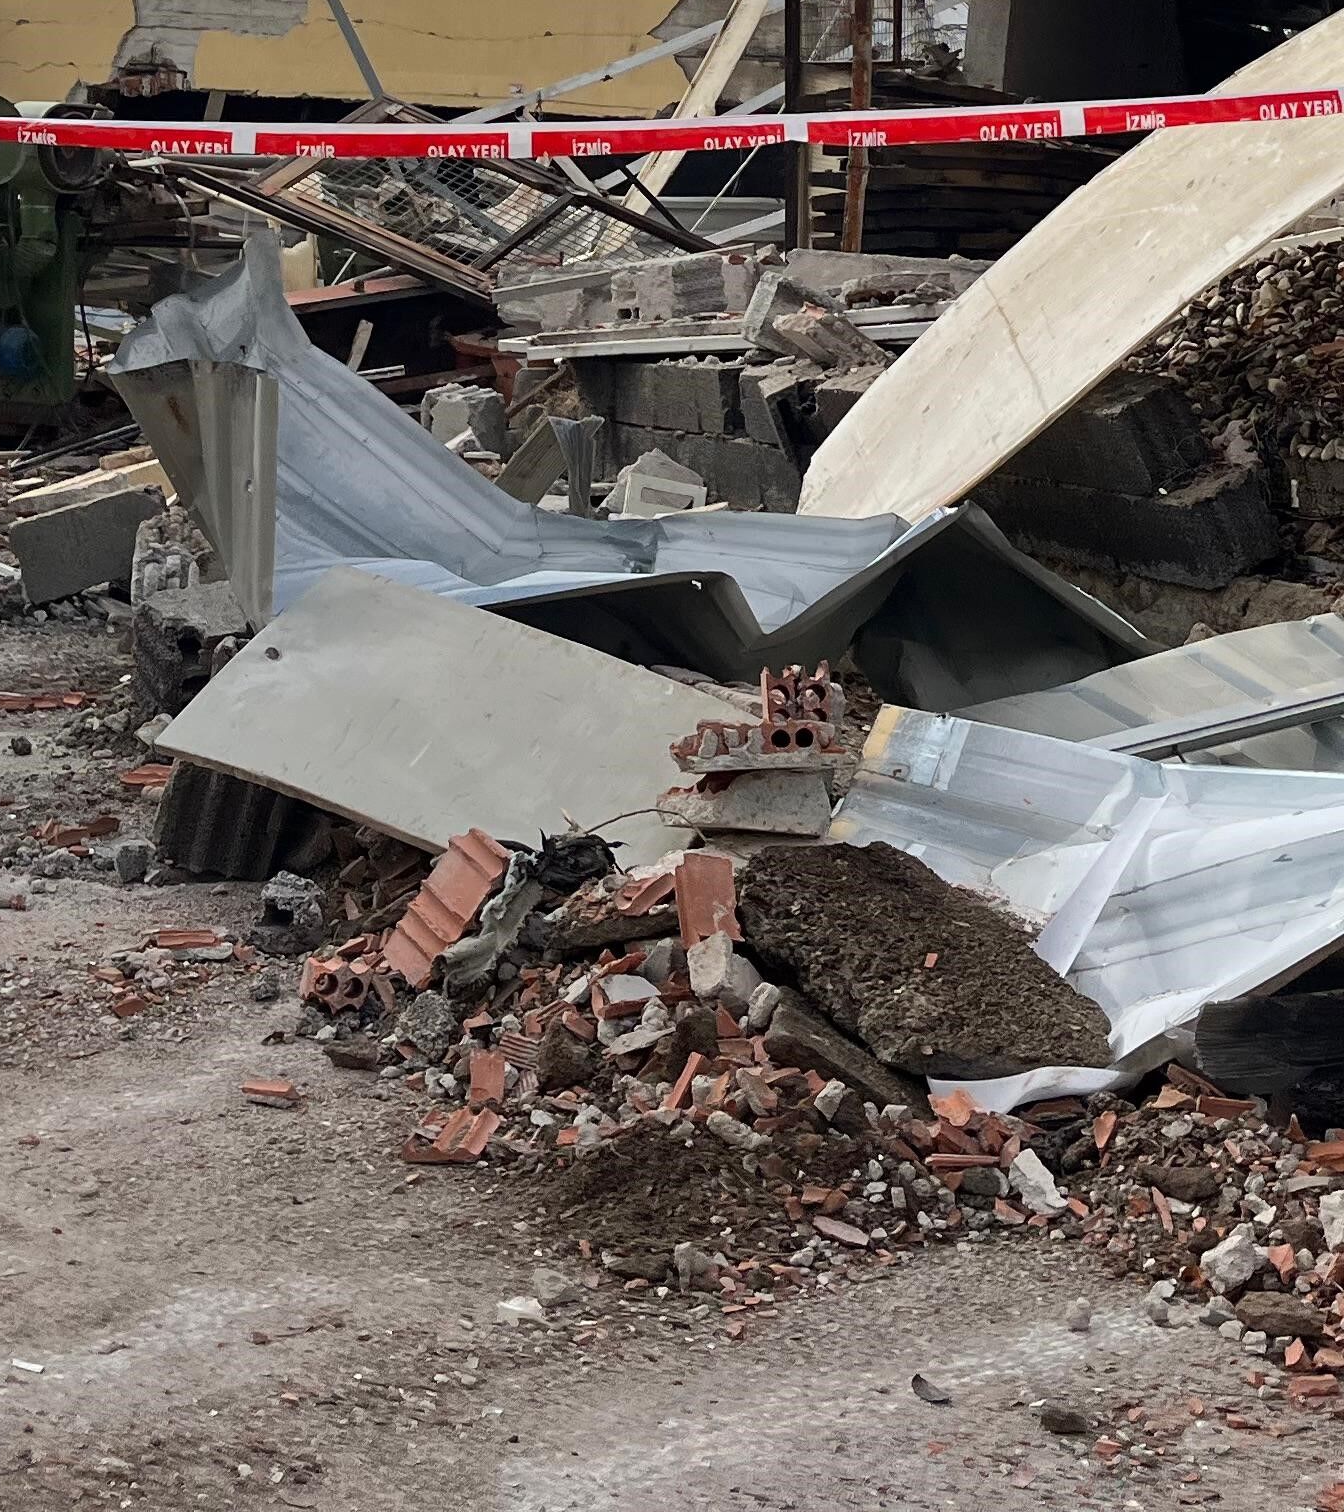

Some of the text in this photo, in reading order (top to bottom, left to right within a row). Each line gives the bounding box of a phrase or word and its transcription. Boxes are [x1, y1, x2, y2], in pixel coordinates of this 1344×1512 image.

[1126, 95, 1338, 130] İZMİR OLAY YERİ
[18, 127, 57, 145] İZMİR
[151, 140, 191, 154] OLAY
[848, 117, 1058, 147] İZMİR OLAY YERİ
[296, 139, 505, 159] İZMİR OLAY YERİ
[572, 138, 611, 156] İZMİR
[704, 136, 743, 150] OLAY
